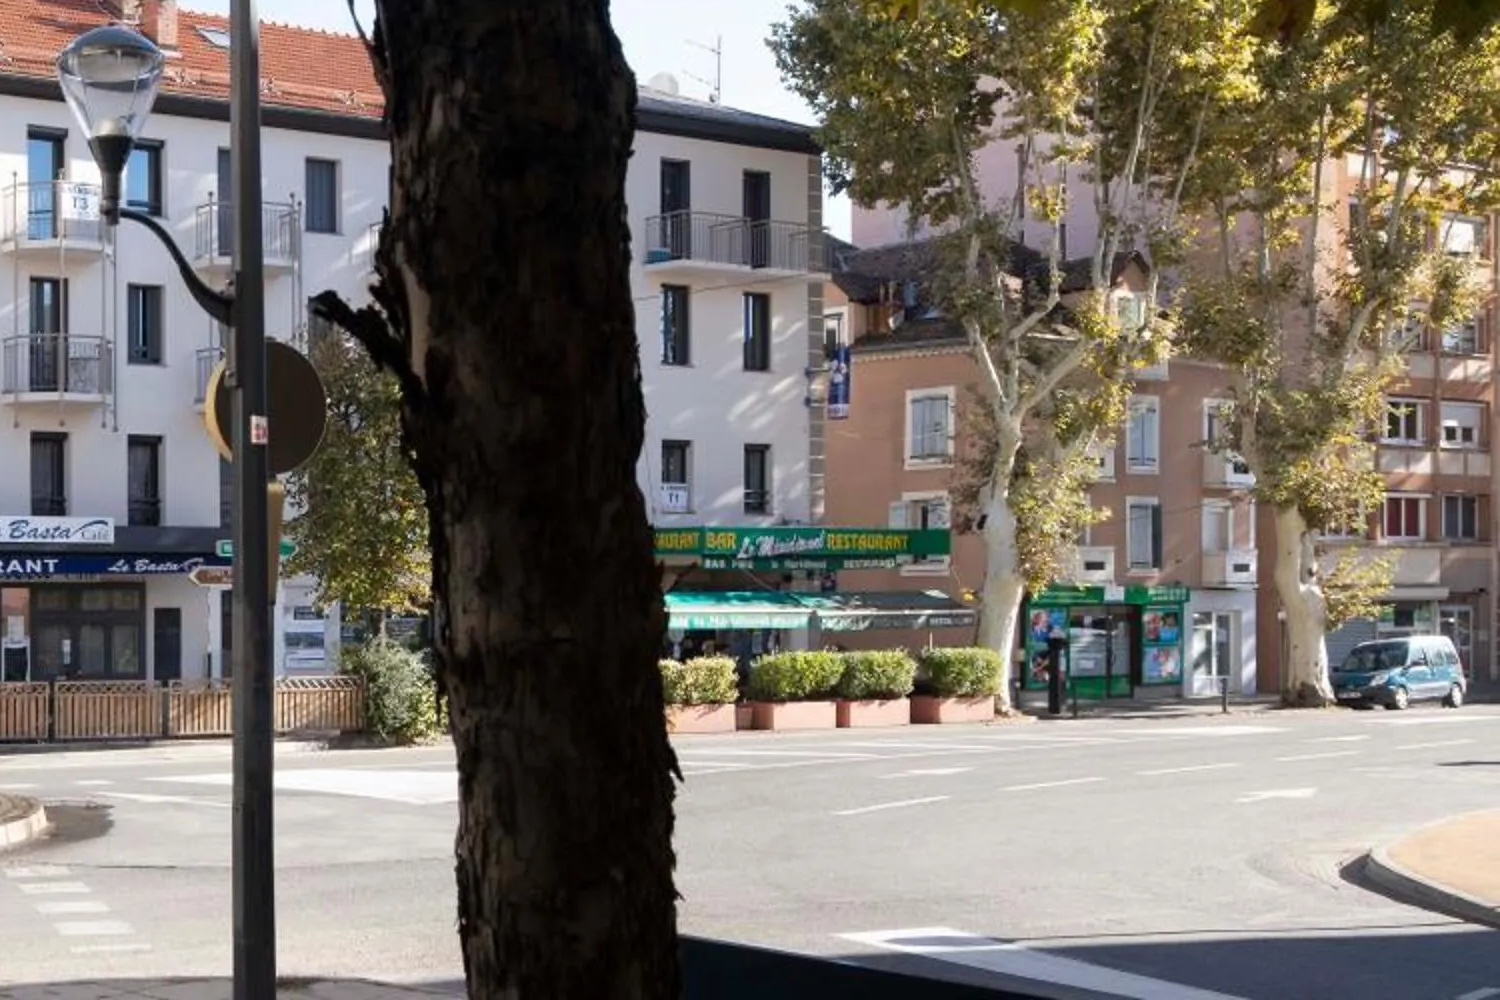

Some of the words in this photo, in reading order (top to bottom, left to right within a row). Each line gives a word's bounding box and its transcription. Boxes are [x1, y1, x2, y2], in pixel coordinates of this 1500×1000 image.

[8, 519, 72, 541] Basta
[705, 531, 737, 550] BAR
[827, 533, 908, 551] RESTAURANT
[107, 558, 129, 574] Le
[133, 558, 180, 573] Basta
